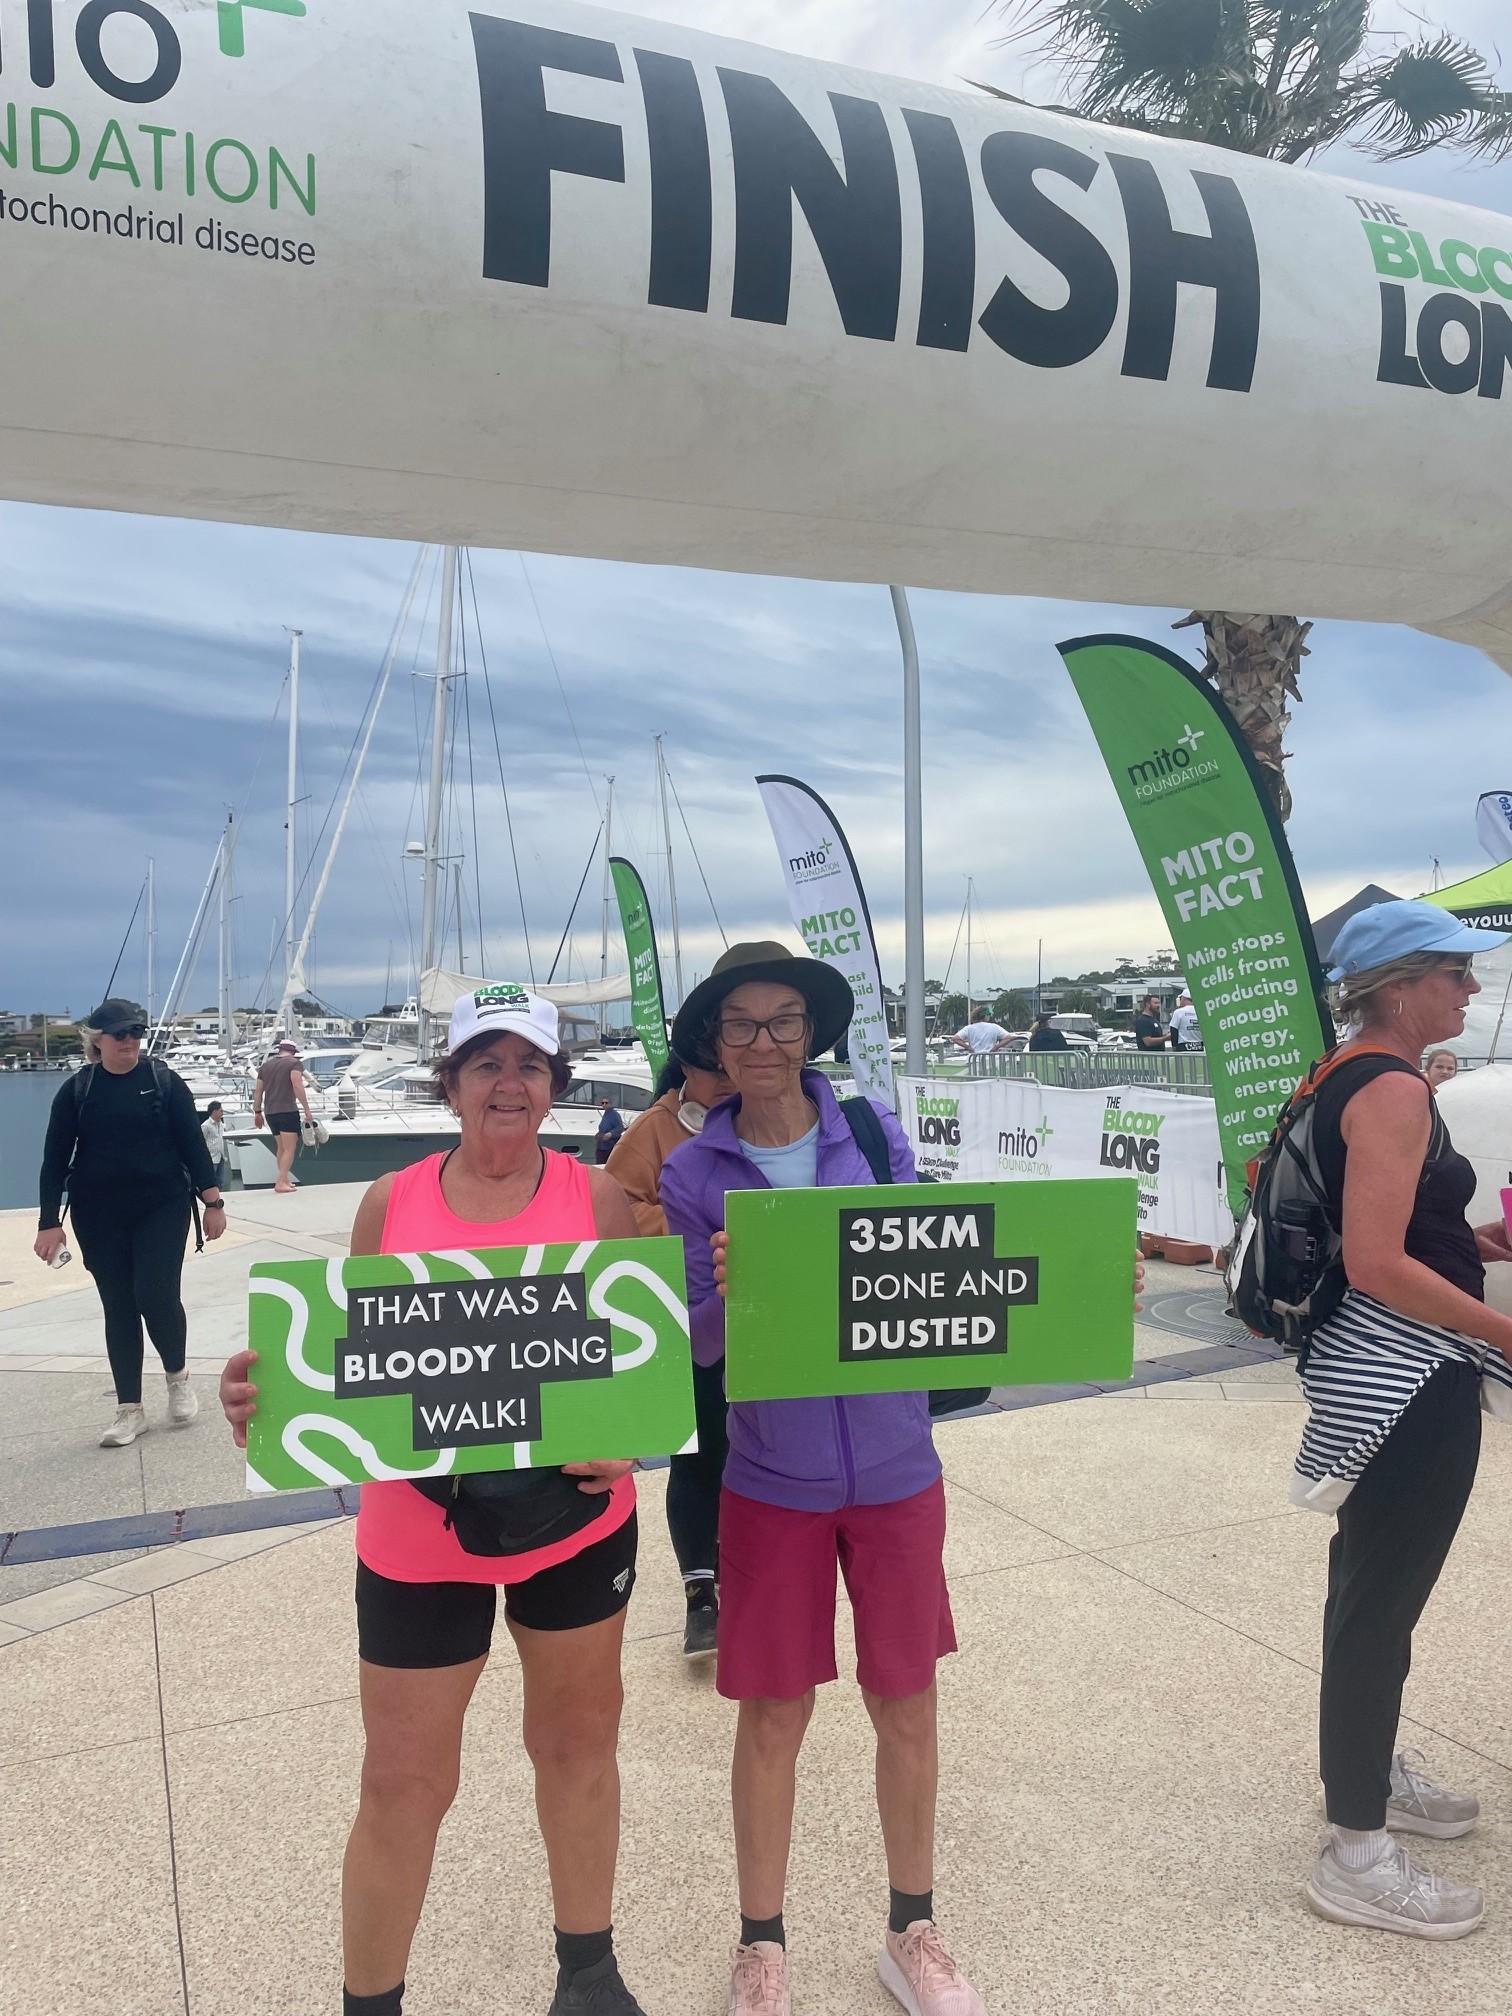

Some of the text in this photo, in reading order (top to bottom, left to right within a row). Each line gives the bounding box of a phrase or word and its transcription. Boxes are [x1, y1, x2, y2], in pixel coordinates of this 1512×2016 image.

[467, 10, 1261, 393] FINISH
[1345, 195, 1408, 227] THE
[195, 217, 316, 265] disease
[1361, 220, 1512, 301] BLOO
[1377, 281, 1512, 400] LON
[1128, 748, 1190, 786] mito
[1136, 759, 1219, 799] FOUNDATION
[789, 851, 826, 871] mito
[793, 861, 840, 880] FOUNDATION
[1160, 831, 1255, 886] MITO
[1174, 867, 1264, 923] FACT
[801, 907, 856, 937] MITO
[1187, 931, 1286, 970] Mito stops
[1201, 954, 1290, 989] cells from
[474, 994, 529, 1009] LONG
[1204, 977, 1299, 1016] producing
[1219, 1000, 1289, 1031] enough
[1223, 1028, 1295, 1053] energy.
[1225, 1048, 1300, 1077] Without
[915, 1086, 926, 1097] THE
[1106, 1096, 1121, 1109] THE
[1234, 1075, 1303, 1099] energy
[916, 1097, 960, 1118] BLOODY
[1103, 1109, 1165, 1137] BLOODY
[1222, 1109, 1246, 1127] our
[918, 1116, 961, 1147] LONG
[998, 1126, 1038, 1159] mito
[1237, 1130, 1270, 1147] can
[999, 1156, 1054, 1177] FOUNDATION
[1100, 1133, 1160, 1174] LONG
[850, 1214, 980, 1253] 35KM
[852, 1269, 1028, 1302] DONE AND
[357, 1282, 578, 1327] THAT WAS A
[852, 1316, 996, 1351] DUSTED
[343, 1335, 607, 1383] BLOODY LONG
[420, 1398, 527, 1434] WALK!
